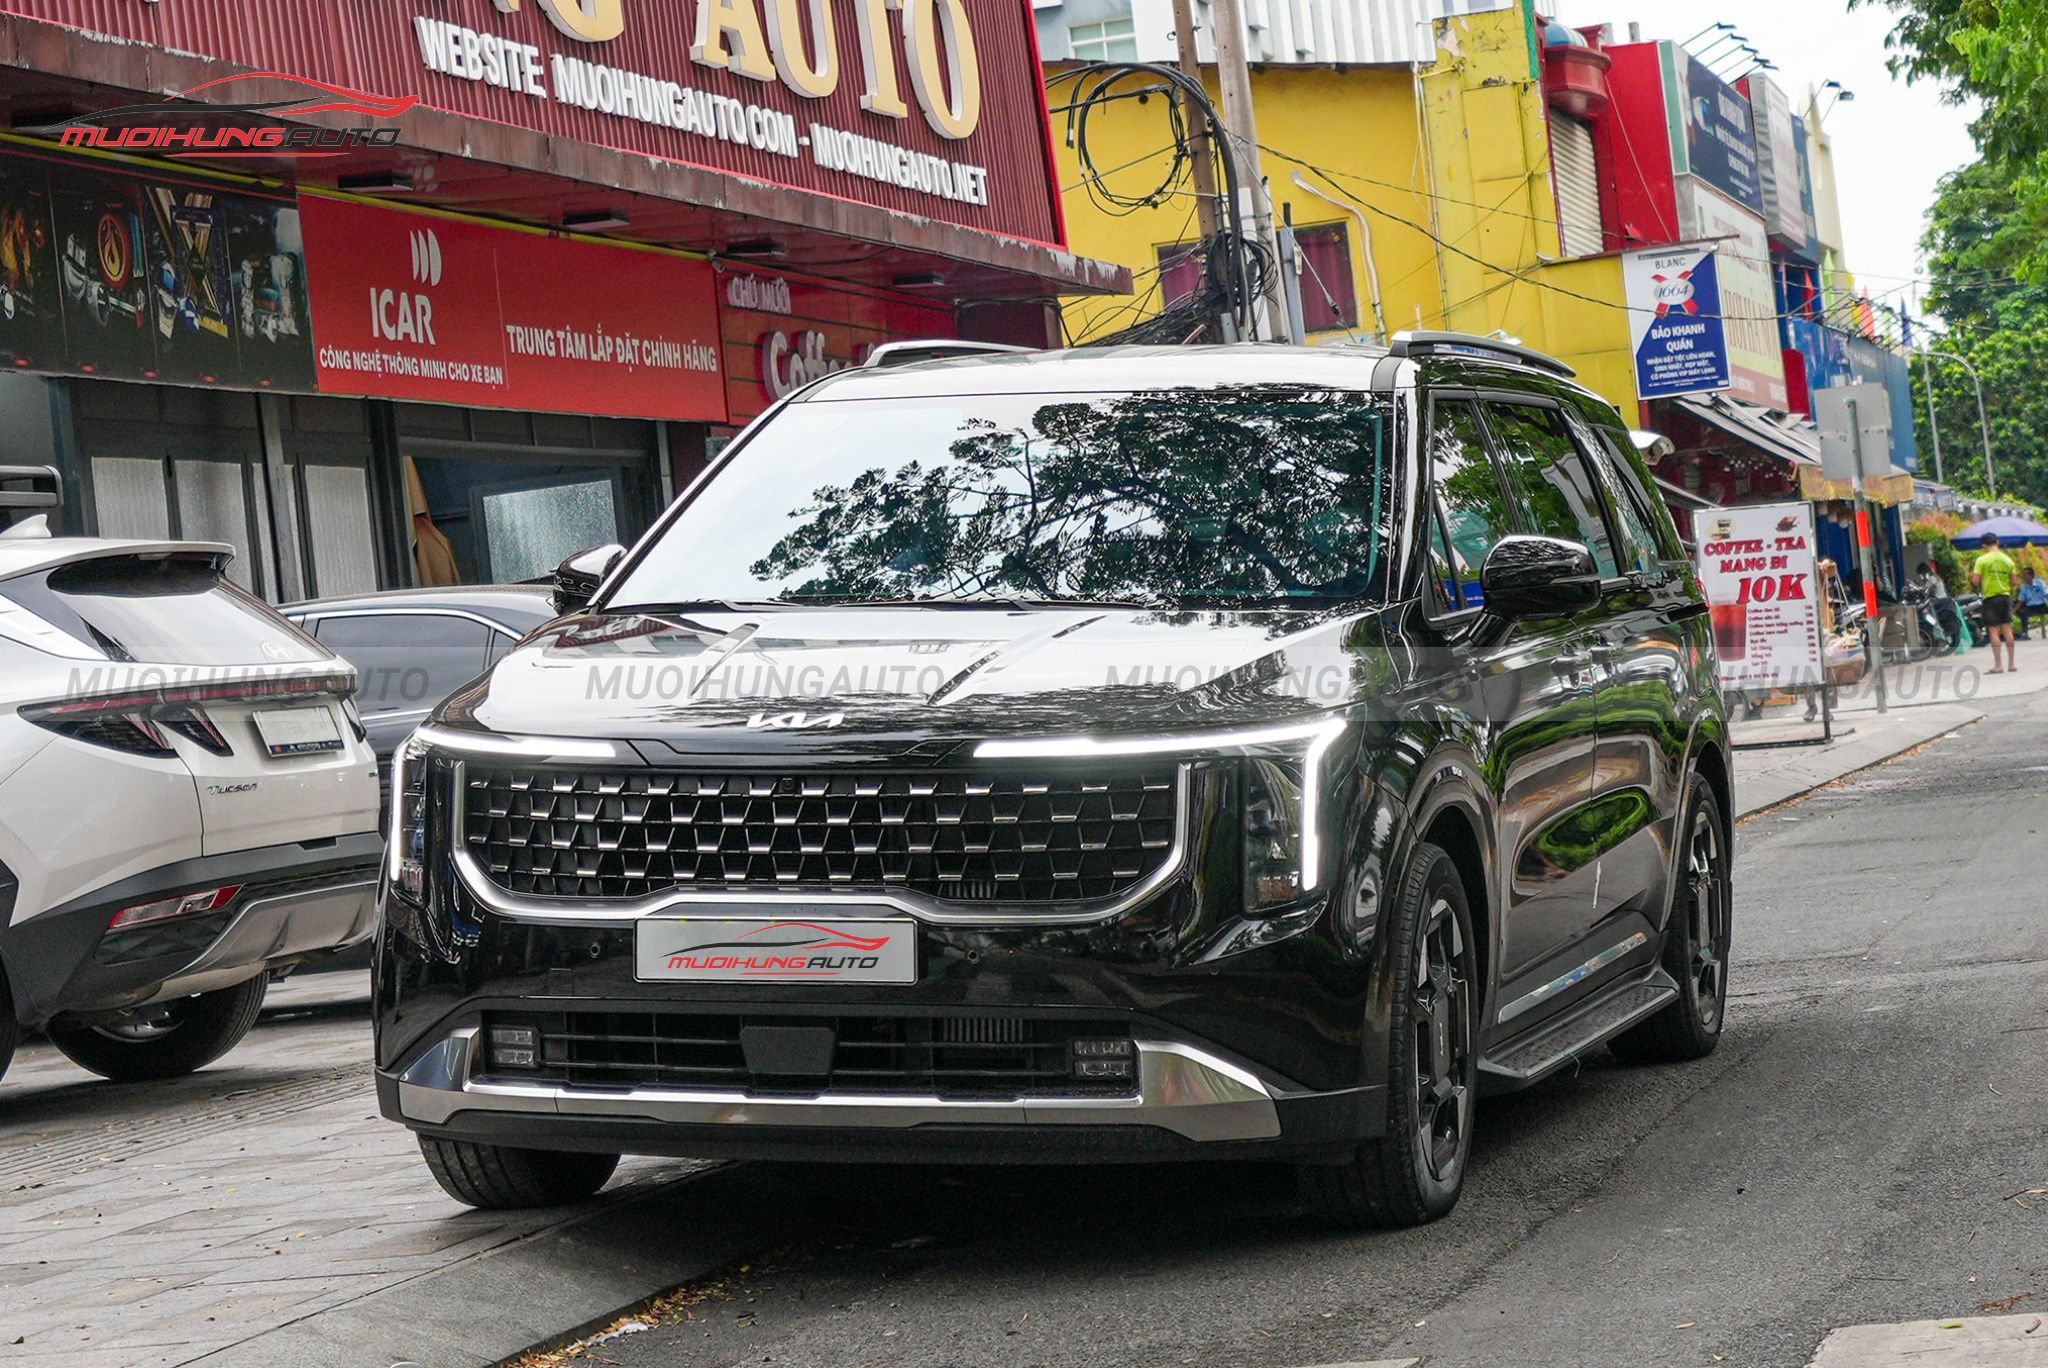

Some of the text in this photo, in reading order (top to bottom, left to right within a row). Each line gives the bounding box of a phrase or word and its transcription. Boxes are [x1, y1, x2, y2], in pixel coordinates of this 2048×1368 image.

[550, 53, 798, 158] MUOIHUNGAUTO.COM
[810, 122, 988, 206] MUOIHUNGAUTO.NET
[1655, 257, 1686, 269] BLANC
[1657, 284, 1690, 299] 1664
[370, 287, 436, 346] ICAR
[1672, 323, 1706, 338] KHANH
[506, 324, 556, 358] TRUNG
[556, 324, 588, 361] TÂM
[589, 322, 614, 362] LẮP
[615, 331, 640, 373] ĐẶT
[642, 334, 682, 369] CHÍNH
[319, 345, 504, 390] CÔNG NGHỆ THÔNG MINH CHO XE BẠN
[763, 330, 853, 402] Coff
[1704, 538, 1764, 557] COFFEE
[1775, 536, 1806, 551] TEA
[1720, 558, 1767, 573] MANG
[1736, 573, 1807, 604] 10K
[206, 781, 259, 796] Tucson
